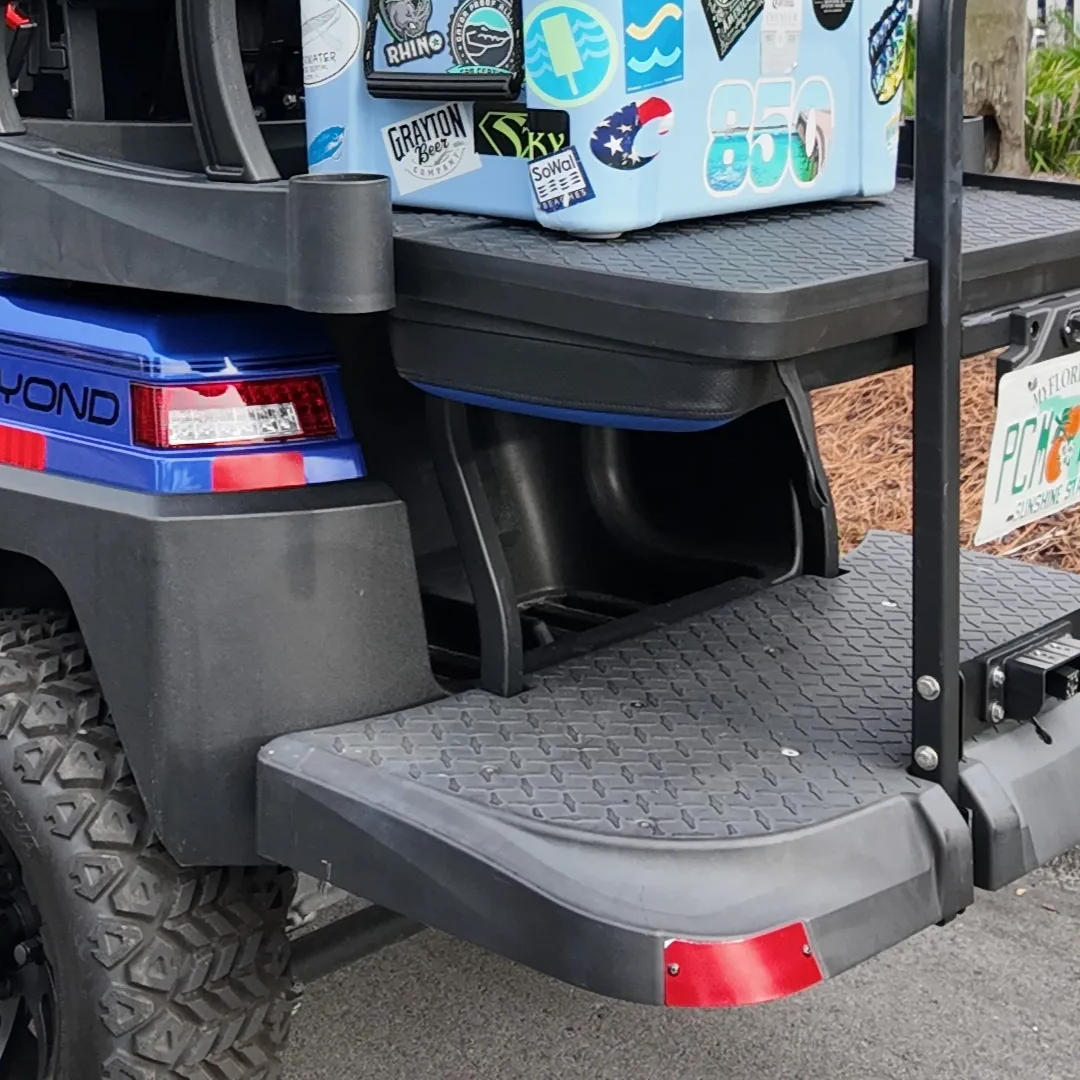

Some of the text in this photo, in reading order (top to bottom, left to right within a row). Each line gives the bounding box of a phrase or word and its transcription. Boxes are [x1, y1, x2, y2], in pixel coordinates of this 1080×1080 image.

[385, 32, 443, 64] RHINO
[387, 102, 467, 162] GRAYTON
[703, 75, 835, 198] 850
[412, 152, 461, 175] COMPANY
[414, 136, 450, 166] Beer
[531, 153, 577, 182] SoWal
[1013, 484, 1064, 520] SUNSHINE
